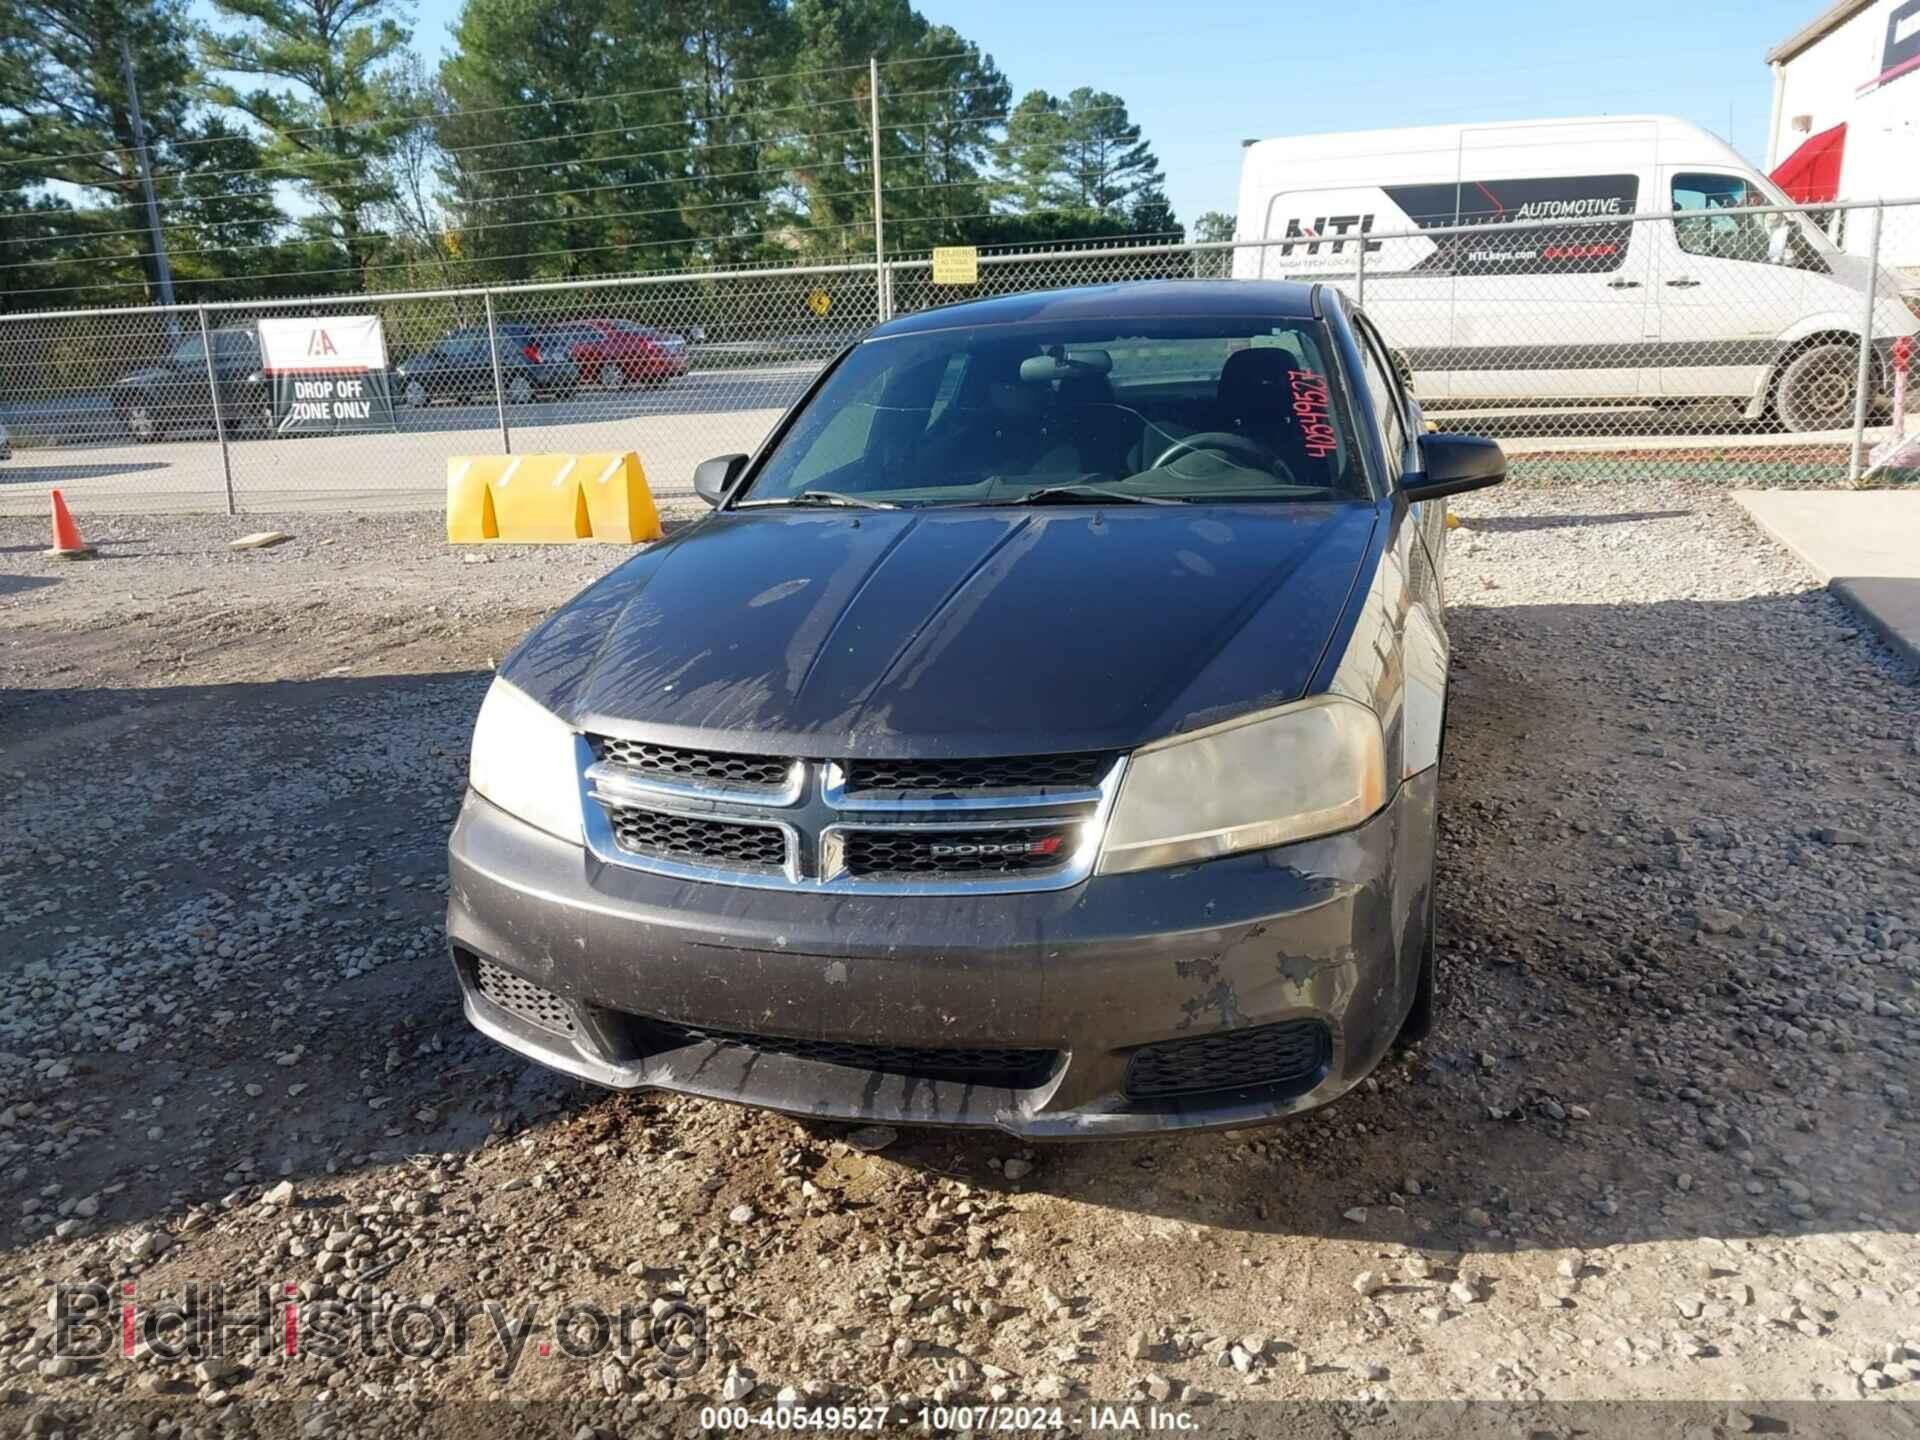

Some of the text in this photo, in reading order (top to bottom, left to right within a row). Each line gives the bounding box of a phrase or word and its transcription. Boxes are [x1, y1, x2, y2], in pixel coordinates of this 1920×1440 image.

[1518, 197, 1621, 217] AUTOMOTIVE
[1280, 214, 1382, 256] HTL
[294, 380, 362, 399] DROP OFF
[292, 401, 370, 420] ZONE ONLY
[1288, 367, 1337, 458] 40549527
[931, 843, 1046, 856] DODGE
